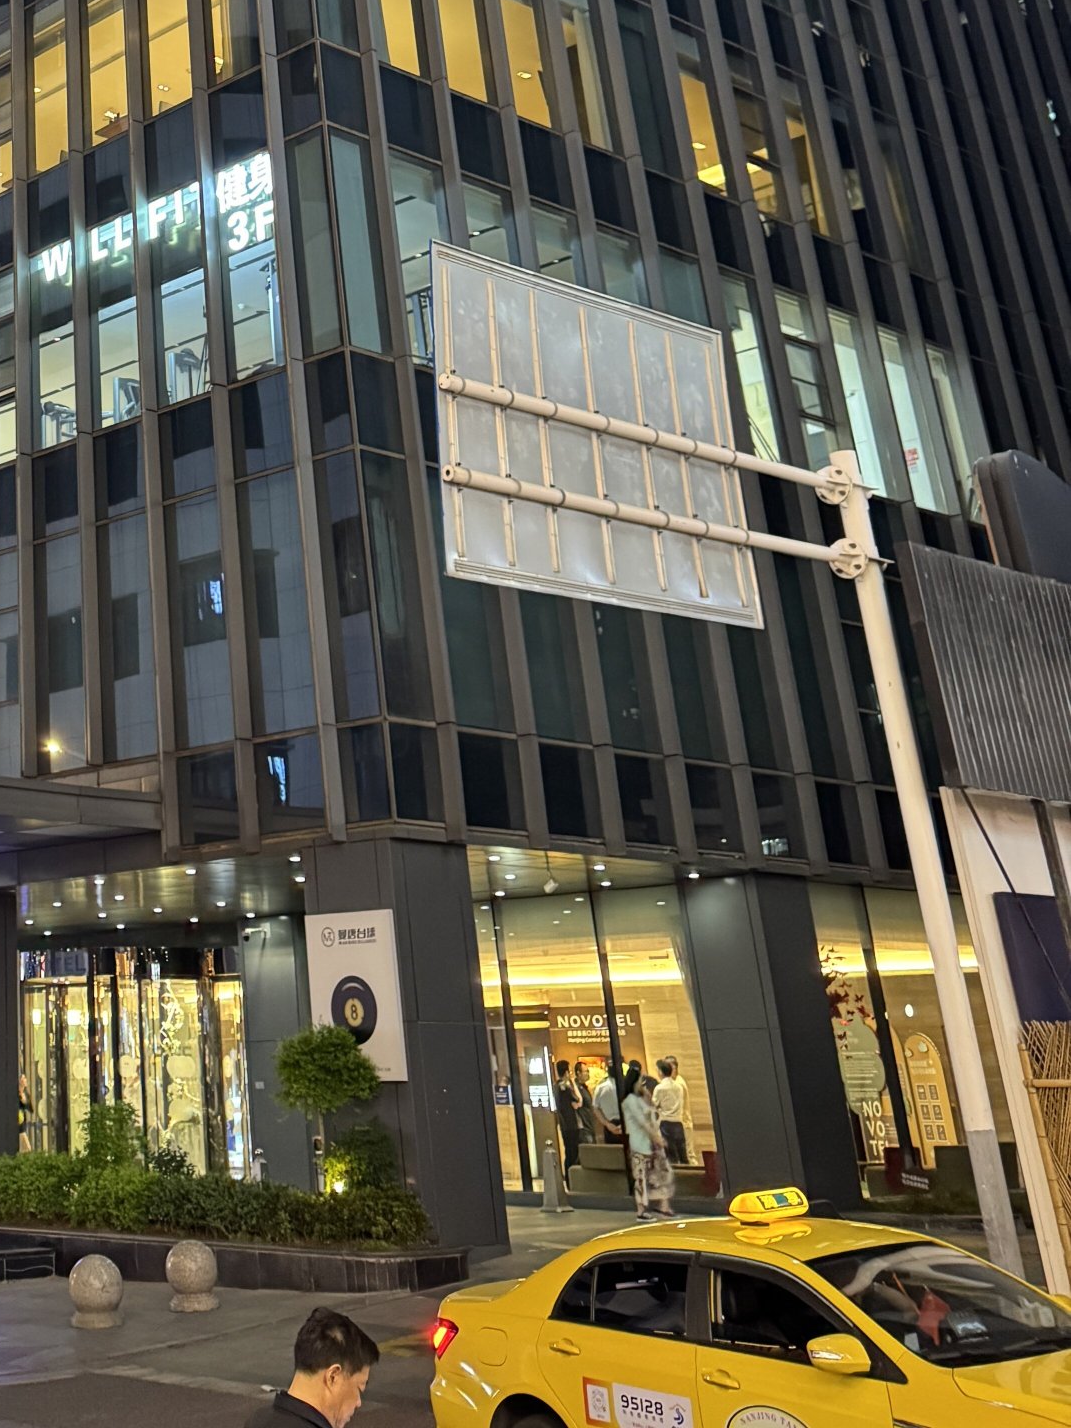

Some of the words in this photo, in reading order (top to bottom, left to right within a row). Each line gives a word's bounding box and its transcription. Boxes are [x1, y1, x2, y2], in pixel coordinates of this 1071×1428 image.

[216, 151, 272, 213] 健身
[228, 200, 274, 251] 3F
[351, 1004, 358, 1020] 8
[557, 1014, 636, 1028] NOVOEL
[862, 1101, 882, 1118] NO
[866, 1120, 886, 1137] VO
[620, 1394, 664, 1416] 95128
[739, 1412, 777, 1425] NANJING
